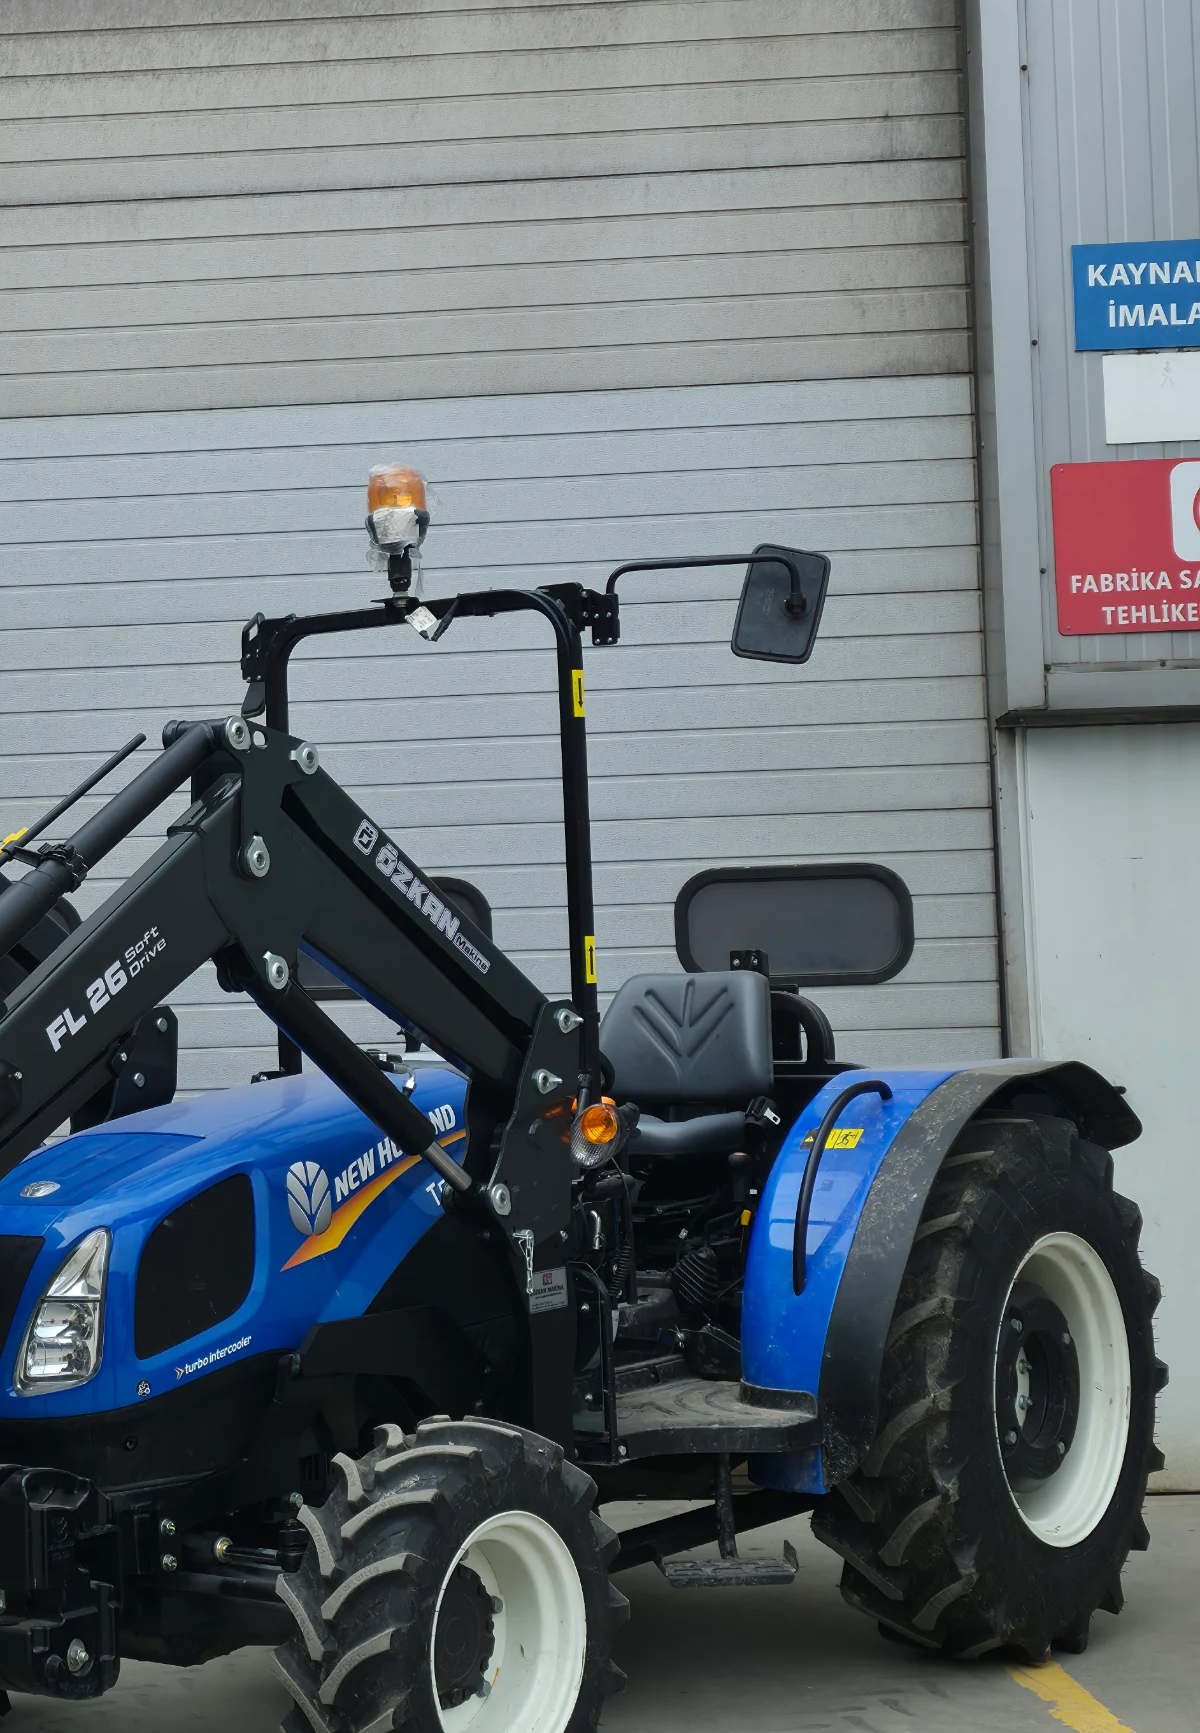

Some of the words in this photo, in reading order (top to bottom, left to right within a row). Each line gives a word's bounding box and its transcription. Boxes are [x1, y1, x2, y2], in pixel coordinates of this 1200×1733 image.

[1087, 260, 1200, 287] KAYNA
[1071, 567, 1173, 594] FABRİKA
[1102, 599, 1199, 626] TEHLİKE
[375, 842, 461, 941] ÖZKAN
[124, 926, 160, 963] Soft
[128, 938, 167, 978] Drive
[456, 935, 489, 971] Makina
[46, 1007, 88, 1053] FL
[86, 960, 128, 1015] 26
[333, 1147, 375, 1203] NEW
[184, 1357, 209, 1375] turbo
[209, 1335, 252, 1364] intercooler
